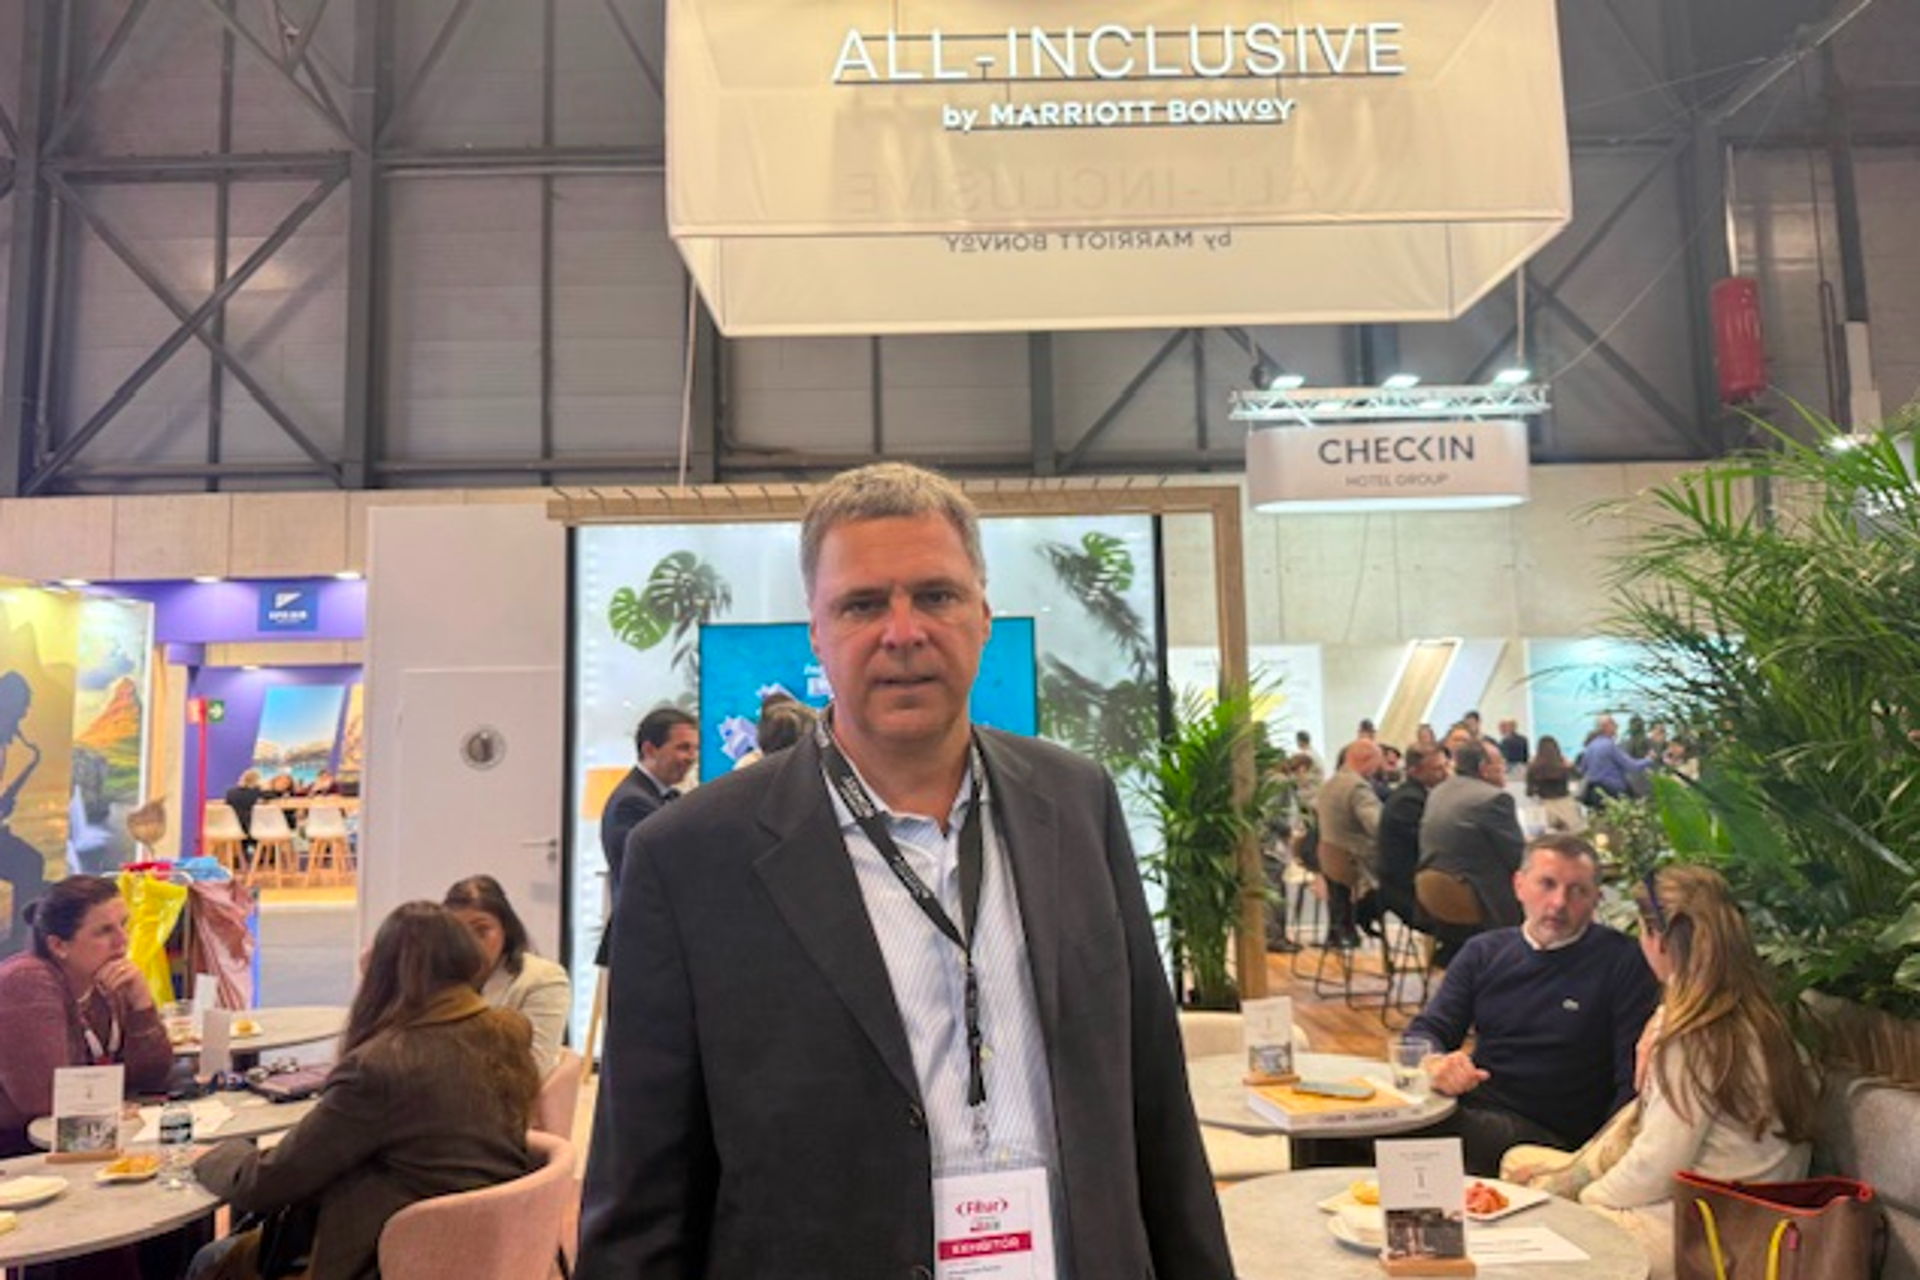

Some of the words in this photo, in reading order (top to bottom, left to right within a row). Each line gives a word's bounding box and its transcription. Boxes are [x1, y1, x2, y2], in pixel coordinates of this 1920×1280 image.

[831, 22, 1406, 81] ALL-INCLUSIVE
[942, 104, 978, 131] by
[990, 100, 1155, 127] MARRIOTT
[1345, 473, 1391, 488] HOTEL
[1394, 472, 1448, 487] GROUP
